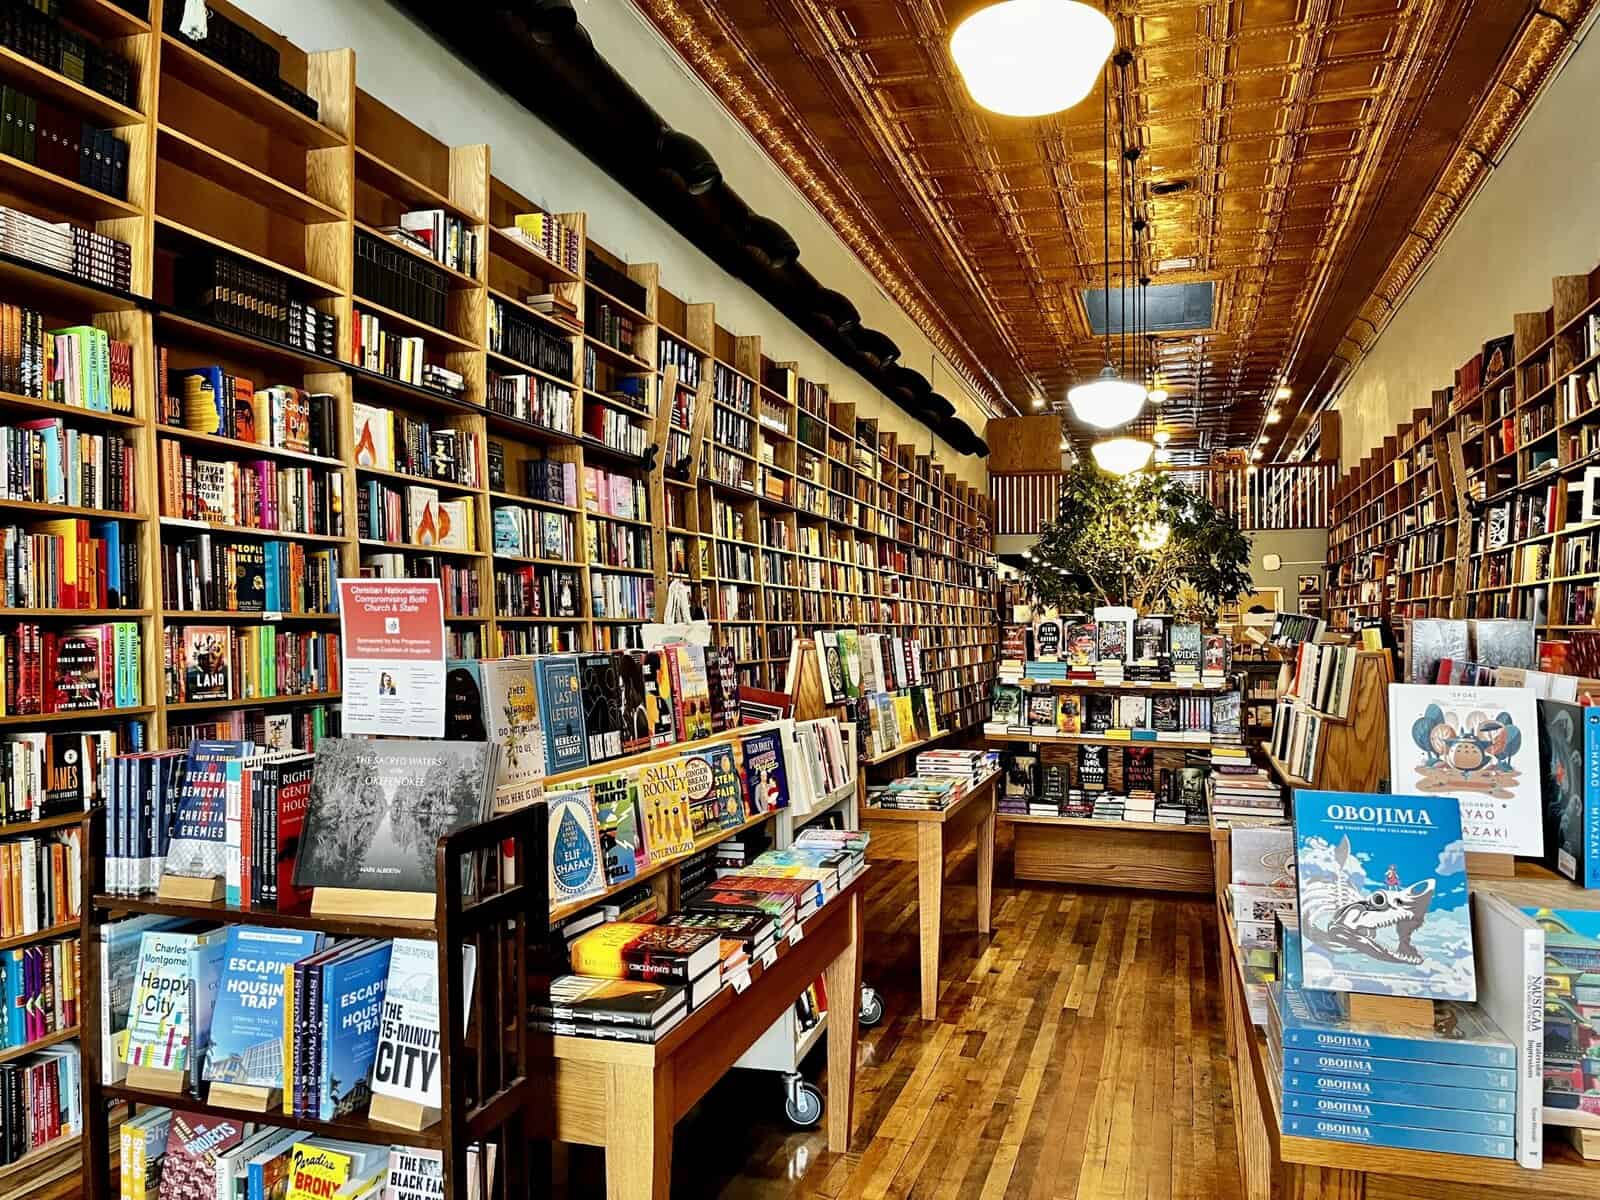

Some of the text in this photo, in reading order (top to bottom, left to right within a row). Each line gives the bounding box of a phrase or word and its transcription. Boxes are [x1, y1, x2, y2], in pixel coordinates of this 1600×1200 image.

[285, 398, 310, 416] Good
[198, 482, 224, 492] ROCERY
[237, 554, 252, 563] IKE
[355, 594, 428, 604] Compromising Both
[364, 604, 390, 612] Church
[400, 604, 420, 612] State
[1174, 650, 1199, 659] WIDE
[196, 673, 224, 687] LAND
[554, 674, 570, 689] THE
[508, 686, 526, 696] THESE
[554, 690, 572, 705] LAST
[553, 706, 578, 722] LETTER
[499, 728, 508, 737] DO
[524, 744, 532, 752] US
[555, 735, 581, 746] REBECCA
[557, 746, 580, 757] YARROS
[372, 757, 404, 766] SACRED
[409, 757, 442, 766] WATERS
[1590, 751, 1598, 787] HAYAO
[186, 772, 225, 783] DEFENDI
[282, 770, 311, 786] RIGHT
[646, 764, 679, 782] SALLY
[686, 768, 708, 778] GINGER
[688, 774, 708, 786] BREAD
[182, 786, 225, 798] DEMOCRA
[282, 784, 311, 800] GENTI
[595, 778, 627, 793] FULL OF
[642, 775, 687, 798] ROONEY
[688, 782, 711, 793] BAKERY
[282, 797, 311, 814] HOLO
[496, 794, 510, 808] THIS
[512, 790, 524, 802] HERE
[526, 792, 531, 800] IS
[180, 810, 224, 822] CHRISTIA
[1328, 804, 1432, 824] OBOJIMA
[1463, 808, 1496, 820] YAO
[181, 825, 224, 838] ENEMIES
[1463, 826, 1508, 838] AZAKI
[564, 848, 581, 862] ELIF
[650, 840, 694, 860] INTERMEZZO
[556, 857, 592, 875] SHAFAK
[155, 944, 187, 955] Charles
[145, 954, 189, 968] Montgome
[229, 958, 289, 976] ESCAPIN
[142, 971, 190, 995] Happy
[227, 980, 284, 998] HOUSIN
[340, 979, 388, 1008] ESCAPI
[146, 995, 175, 1019] City
[240, 994, 277, 1009] TRAP
[1532, 976, 1542, 1032] NAUSICAA
[342, 1004, 382, 1029] HOUSI
[384, 1002, 404, 1020] THE
[308, 978, 318, 1086] STRONG TOWNS
[356, 1019, 379, 1036] TRA
[382, 1020, 440, 1048] 15-MINUT
[1318, 1034, 1370, 1048] OBOJIMA
[376, 1040, 439, 1092] CITY
[1320, 1056, 1372, 1072] OBOJIMA
[1526, 1040, 1536, 1078] Impressions
[1318, 1078, 1370, 1092] OBOJIMA
[1318, 1100, 1370, 1114] OBOJIMA
[145, 1124, 169, 1145] Sha
[1318, 1122, 1370, 1137] OBOJIMA
[184, 1122, 236, 1156] PROJECTS
[294, 1150, 336, 1173] Paradise
[400, 1156, 416, 1172] THE
[296, 1172, 341, 1199] BRONX
[391, 1172, 424, 1190] BLACK
